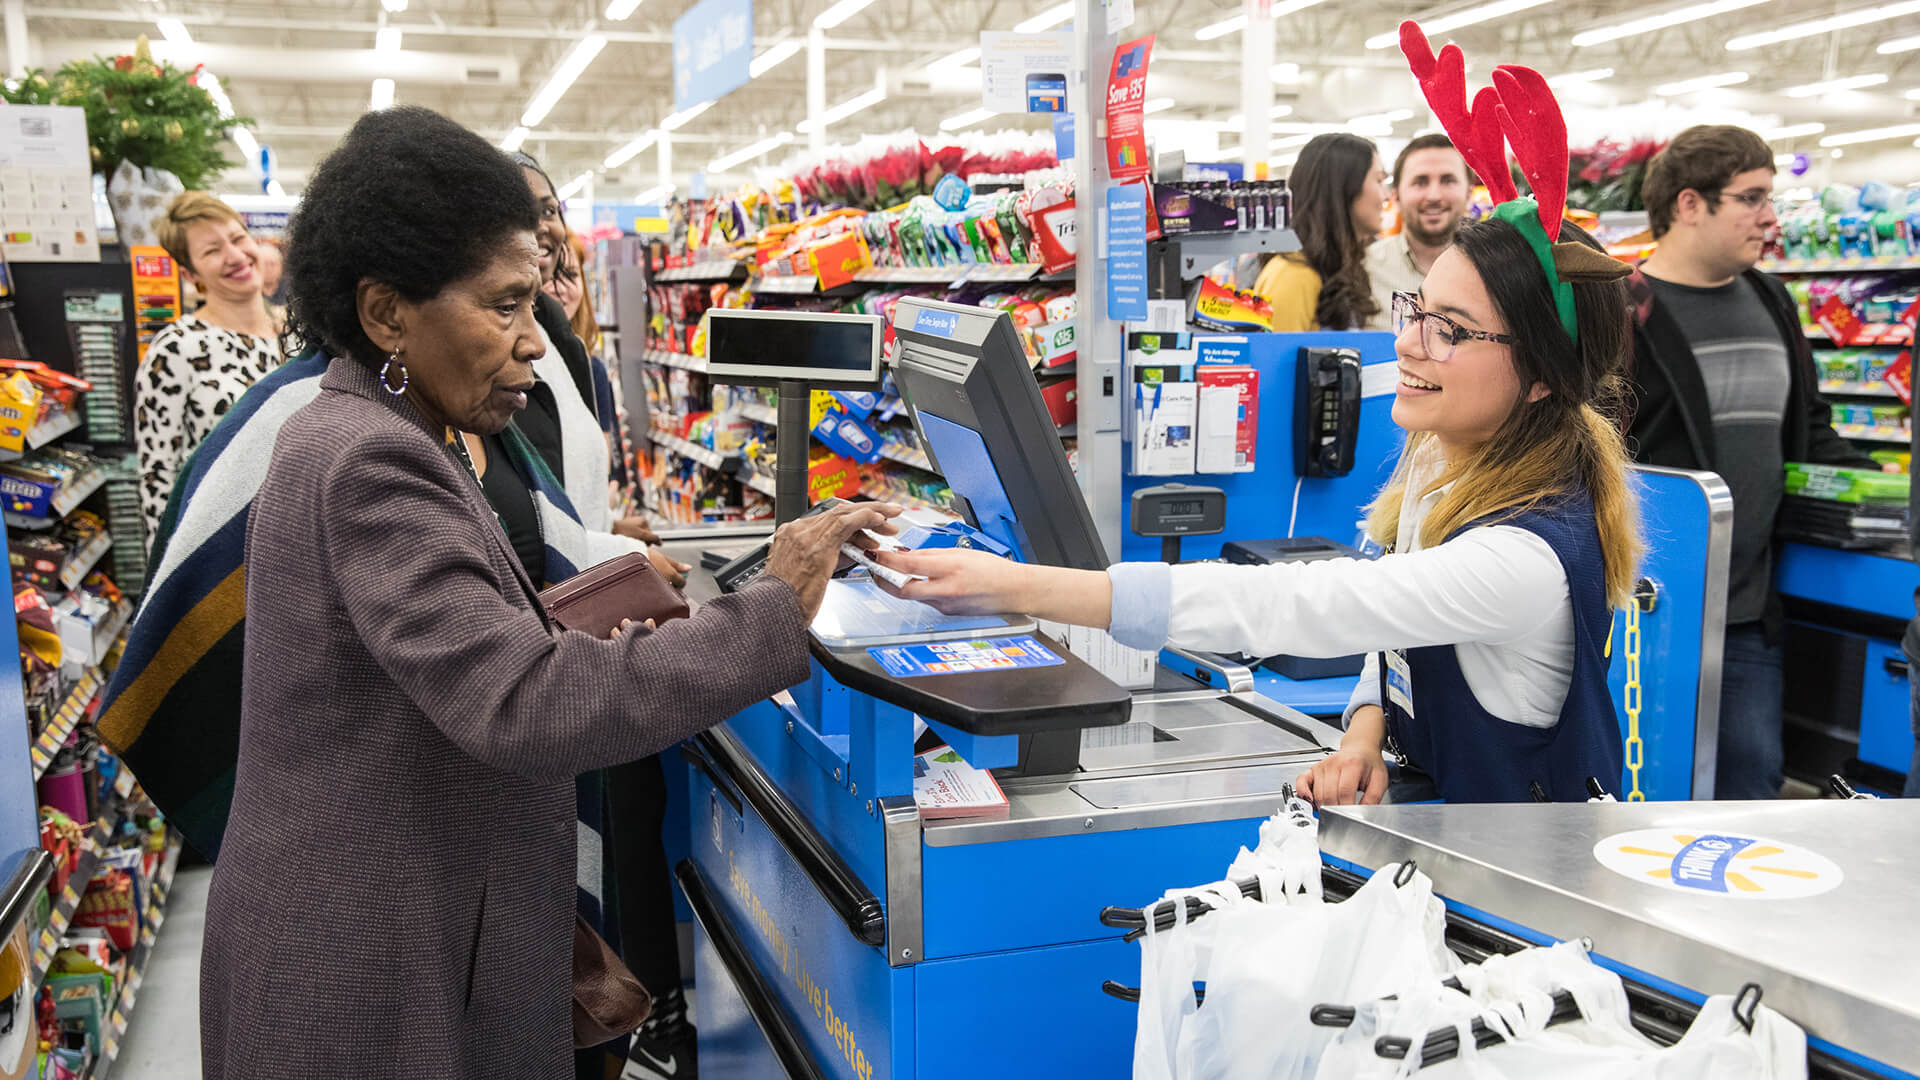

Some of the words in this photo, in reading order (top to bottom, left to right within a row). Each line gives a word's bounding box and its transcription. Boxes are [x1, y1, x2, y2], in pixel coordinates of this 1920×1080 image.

[1108, 84, 1128, 104] Save
[1679, 846, 1725, 880] THINK
[729, 850, 750, 907] Save
[795, 948, 822, 1018] Live
